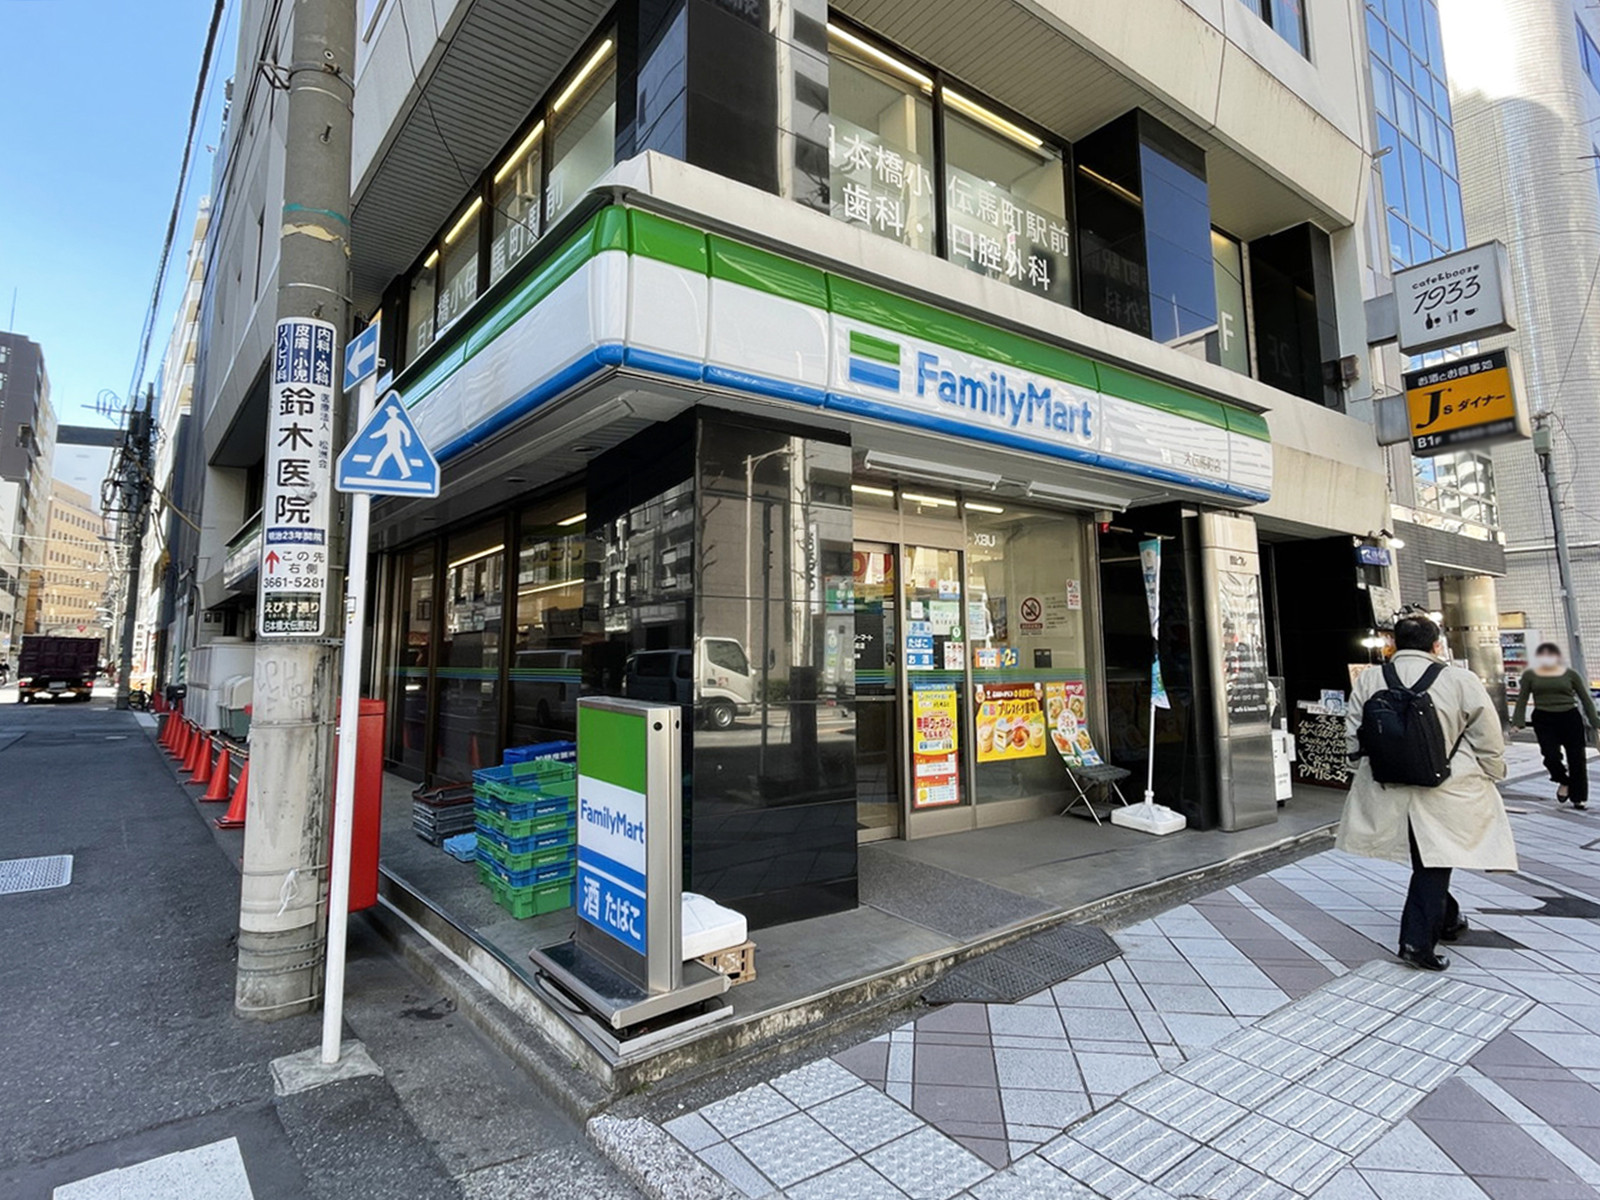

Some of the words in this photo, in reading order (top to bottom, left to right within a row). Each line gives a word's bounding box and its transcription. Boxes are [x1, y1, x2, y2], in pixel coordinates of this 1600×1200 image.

[1411, 263, 1480, 290] cafe&booze
[1413, 275, 1481, 315] 1933
[277, 325, 289, 381] リハビリ科
[293, 325, 310, 382] 皮膚・小児
[315, 328, 331, 385] 内科・外科
[1417, 360, 1494, 386] お酒とお食事処
[917, 351, 1092, 438] FamilyMart
[1458, 395, 1506, 412] ダイナー
[275, 387, 315, 524] 鈴木医院
[282, 551, 325, 563] この先
[289, 563, 318, 575] 右側
[264, 577, 325, 589] 3661-5281
[265, 601, 320, 613] えびす通り
[580, 799, 645, 844] FamilyMart
[583, 875, 600, 920] 酒
[605, 891, 641, 940] たばこ
